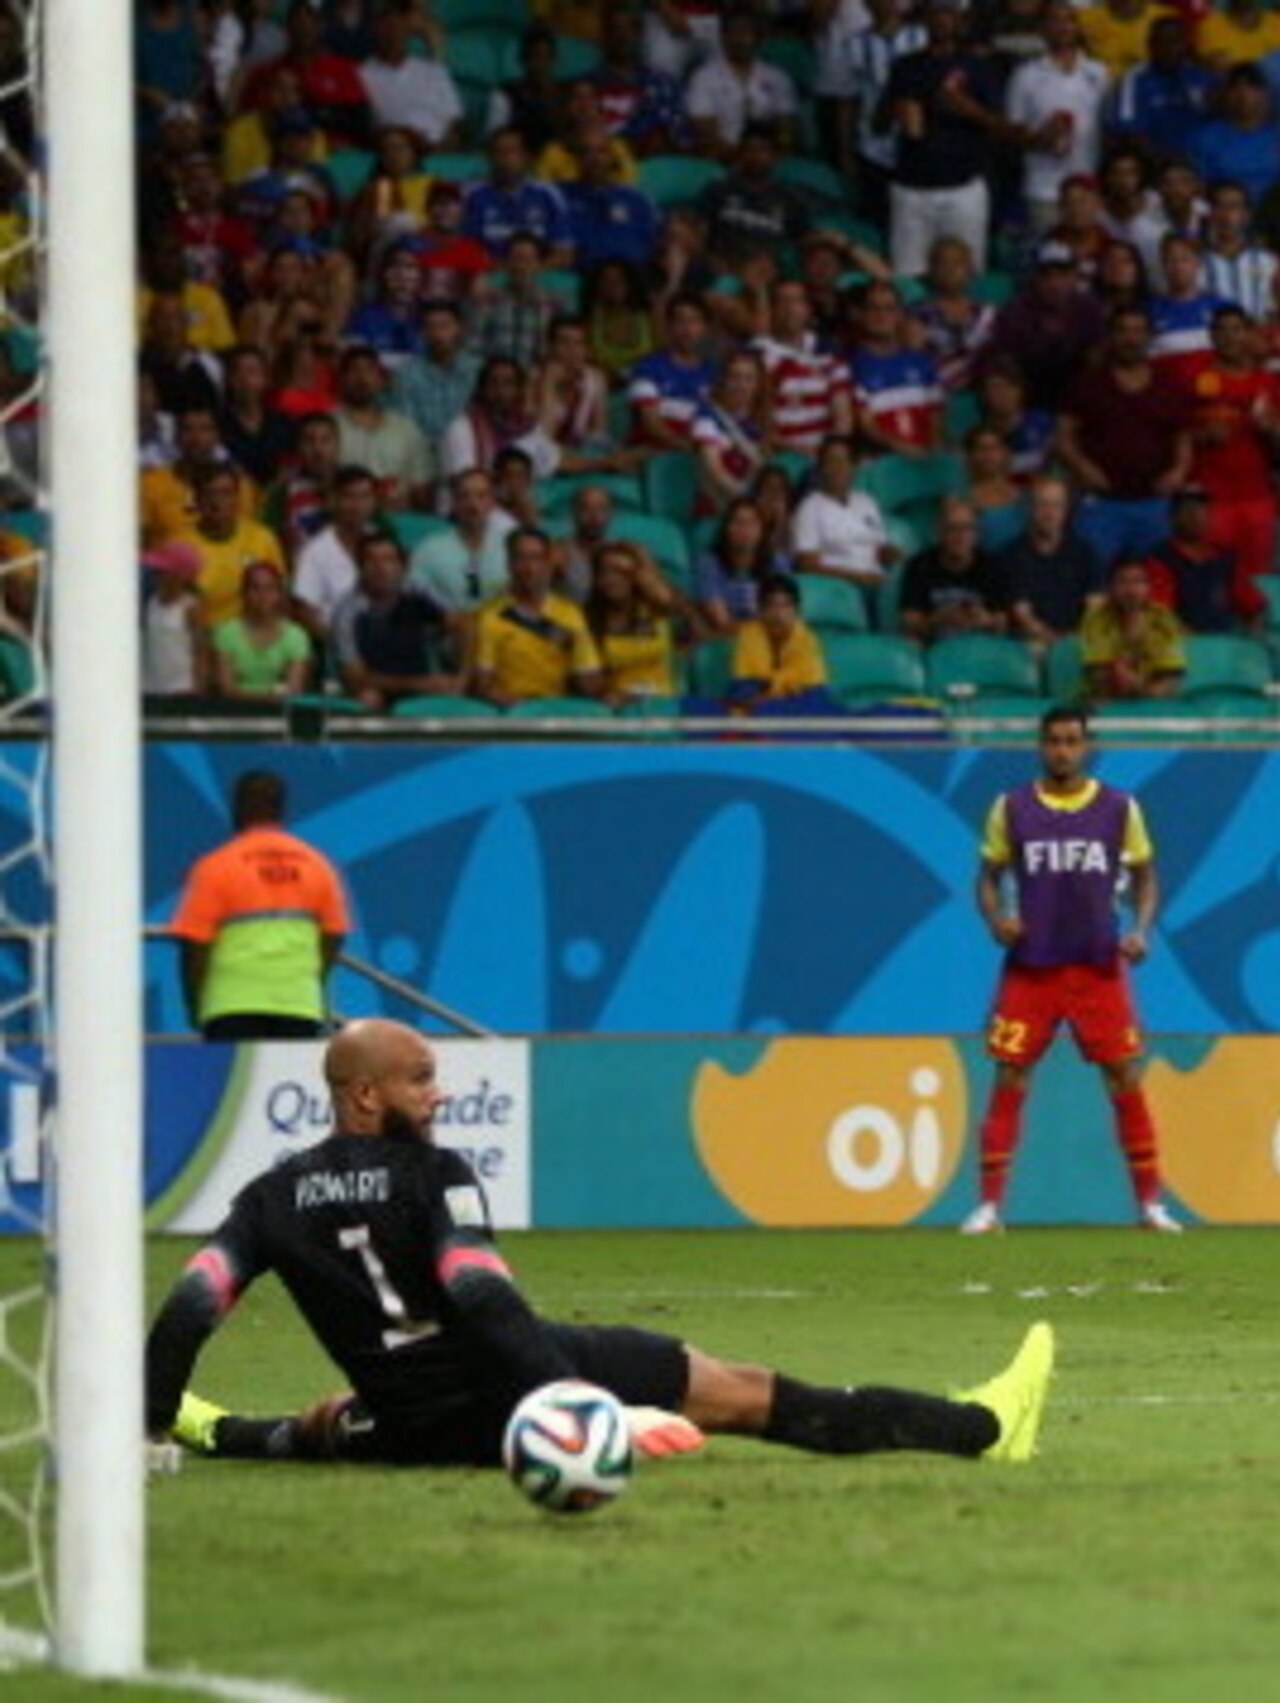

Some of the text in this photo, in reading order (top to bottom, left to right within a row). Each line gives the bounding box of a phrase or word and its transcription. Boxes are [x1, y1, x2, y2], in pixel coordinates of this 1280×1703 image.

[1023, 841, 1107, 873] FIFA
[989, 1015, 1027, 1053] 22
[266, 1078, 512, 1133] Quade
[827, 1066, 941, 1189] oi
[338, 1224, 441, 1350] 1
